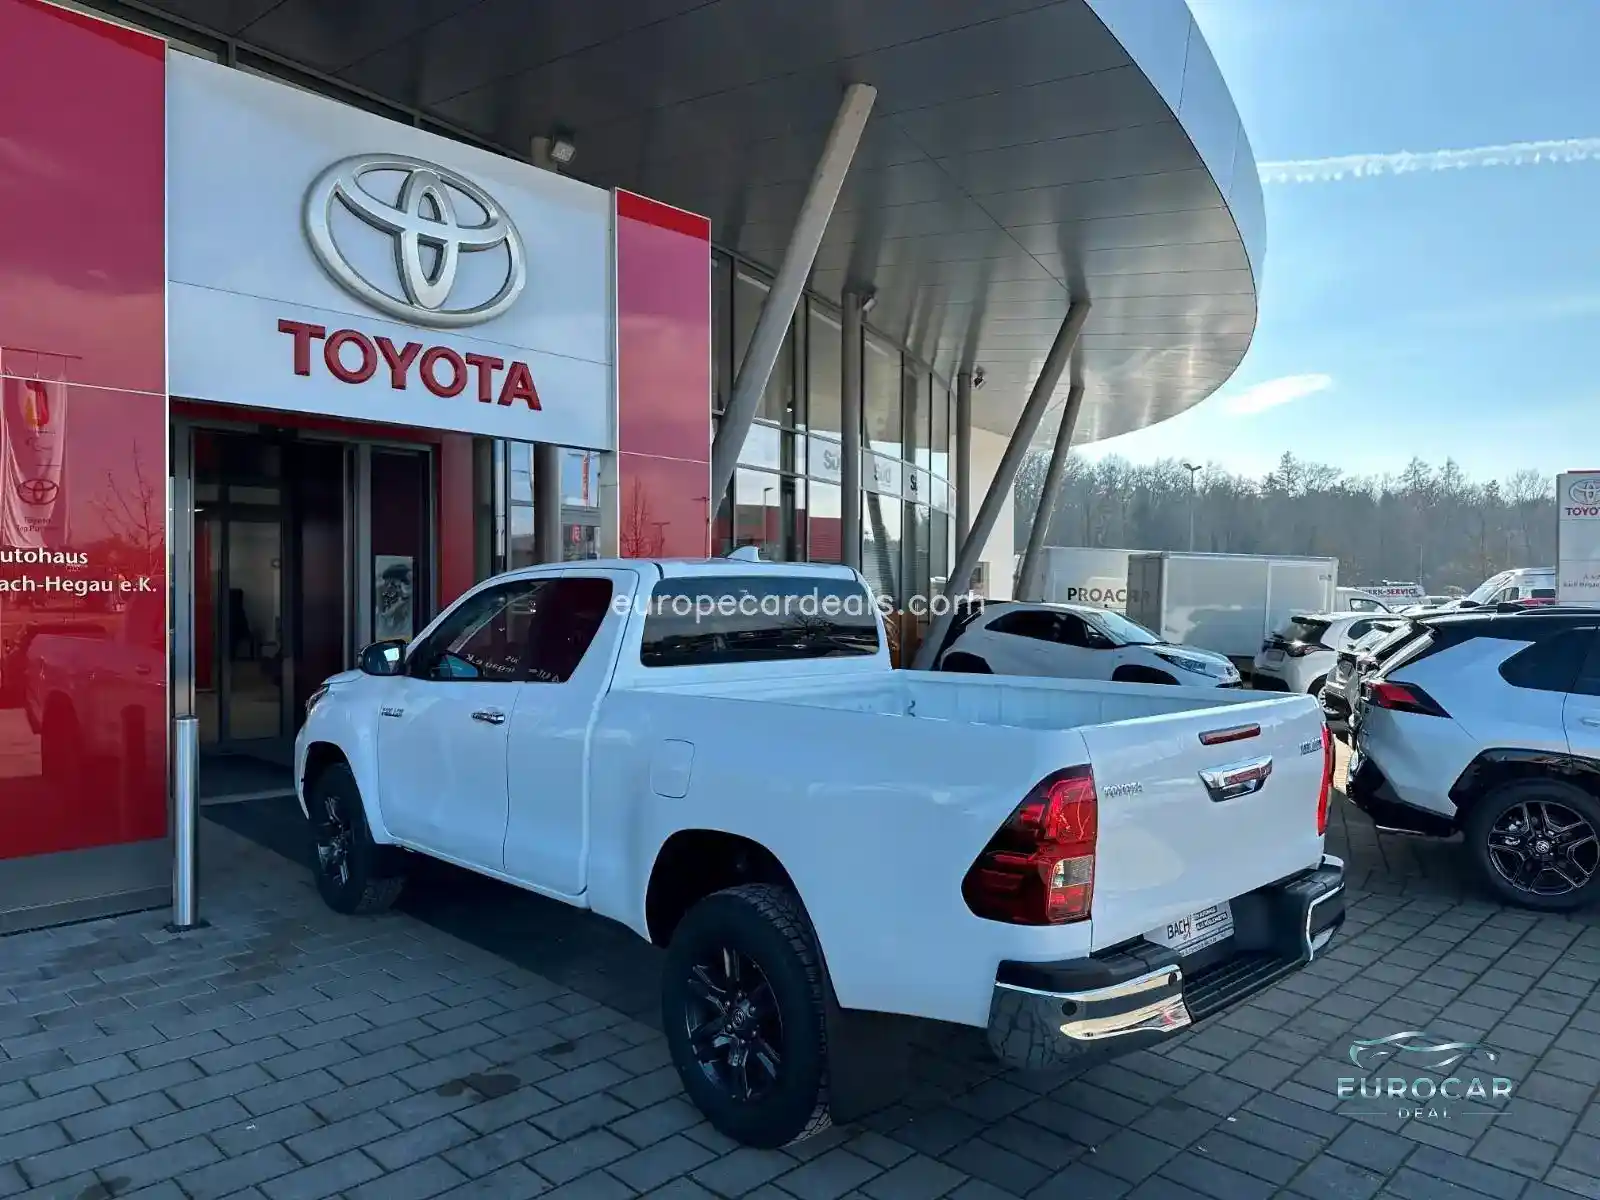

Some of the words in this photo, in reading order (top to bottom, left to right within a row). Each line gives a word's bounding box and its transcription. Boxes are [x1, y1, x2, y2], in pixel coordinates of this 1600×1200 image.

[278, 319, 542, 411] TOYOTA
[1565, 506, 1600, 516] TOYO
[121, 577, 157, 592] e.K.
